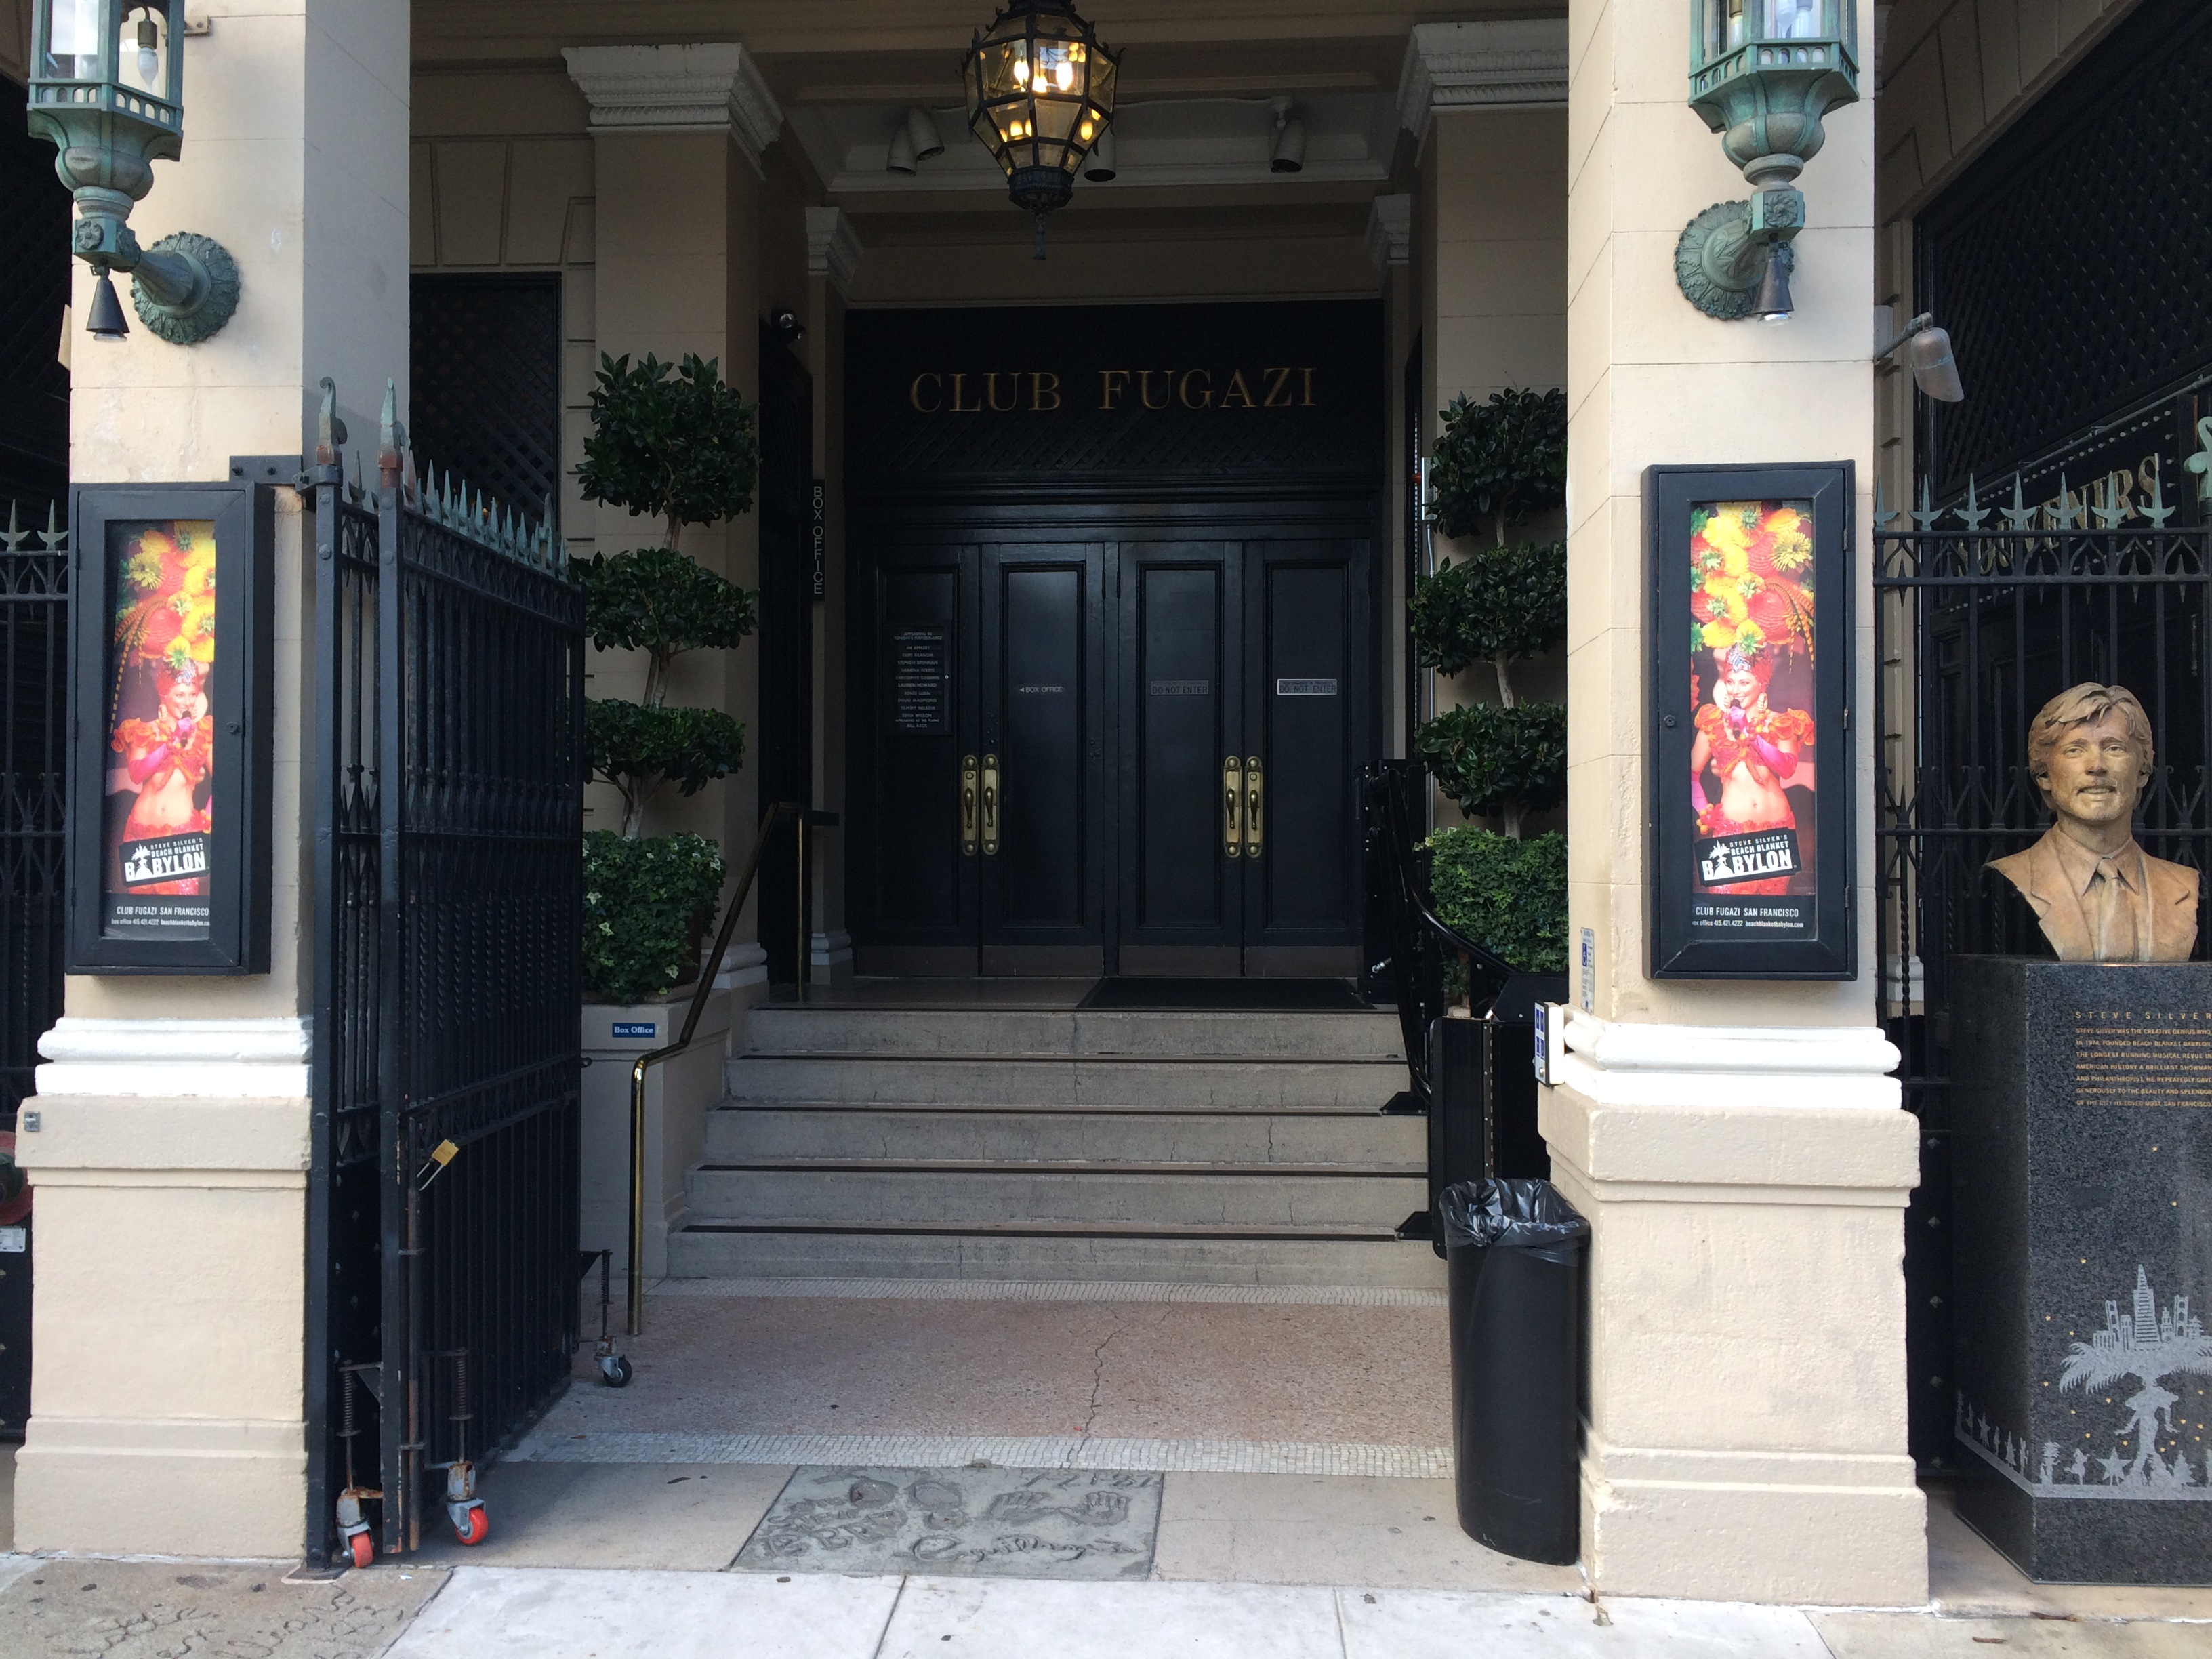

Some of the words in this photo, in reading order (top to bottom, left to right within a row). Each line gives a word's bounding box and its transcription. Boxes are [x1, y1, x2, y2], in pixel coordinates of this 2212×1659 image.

[909, 371, 1062, 412] CLUB
[1098, 367, 1317, 410] FUGAZI
[813, 486, 823, 520] BOX
[813, 525, 823, 594] OFFICE
[1152, 686, 1163, 694] DO
[150, 842, 169, 850] STEVE
[173, 838, 203, 846] SILVER'S
[1729, 839, 1752, 848] STEVE
[1755, 834, 1788, 844] SILVER'S
[1731, 845, 1755, 856] BEACH
[1757, 840, 1789, 853] BLANKET
[151, 848, 173, 857] BEACH
[174, 843, 203, 854] BLANKET
[117, 906, 134, 915] CLUB
[135, 906, 157, 915] FUGAZI
[159, 907, 172, 915] SAN
[174, 907, 209, 916] FRANCISCO
[1696, 907, 1713, 916] CLUB
[1716, 907, 1740, 916] FUGAZI
[1744, 908, 1758, 916] SAN
[1760, 908, 1799, 917] FRANCISCO
[2075, 1011, 2131, 1019] STEVE
[2144, 1012, 2212, 1020] SILVER
